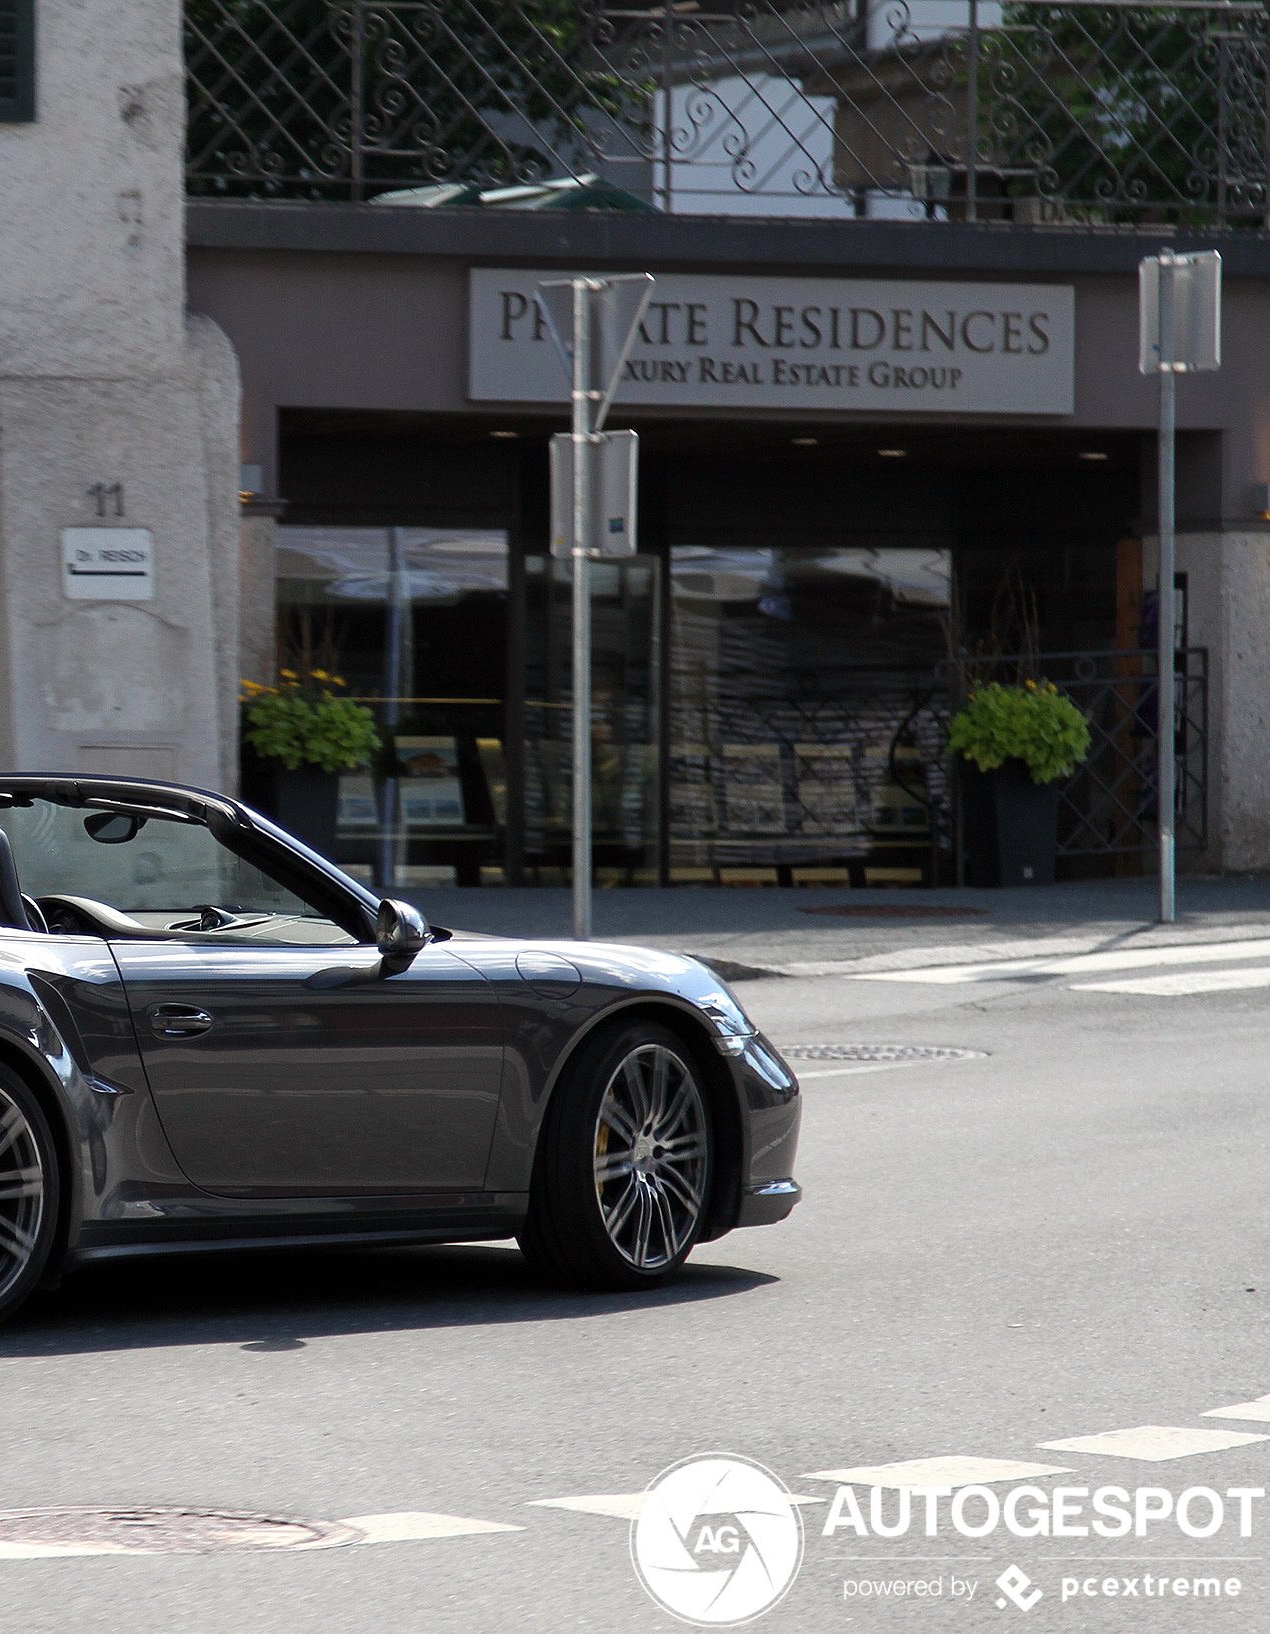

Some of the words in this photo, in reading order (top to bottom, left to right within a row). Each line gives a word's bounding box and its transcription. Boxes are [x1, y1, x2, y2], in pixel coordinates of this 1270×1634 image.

[731, 297, 1050, 355] RESIDENCES
[697, 355, 764, 385] REAL
[770, 357, 860, 388] ESTATE
[867, 359, 963, 391] GROUP
[87, 482, 125, 517] 11
